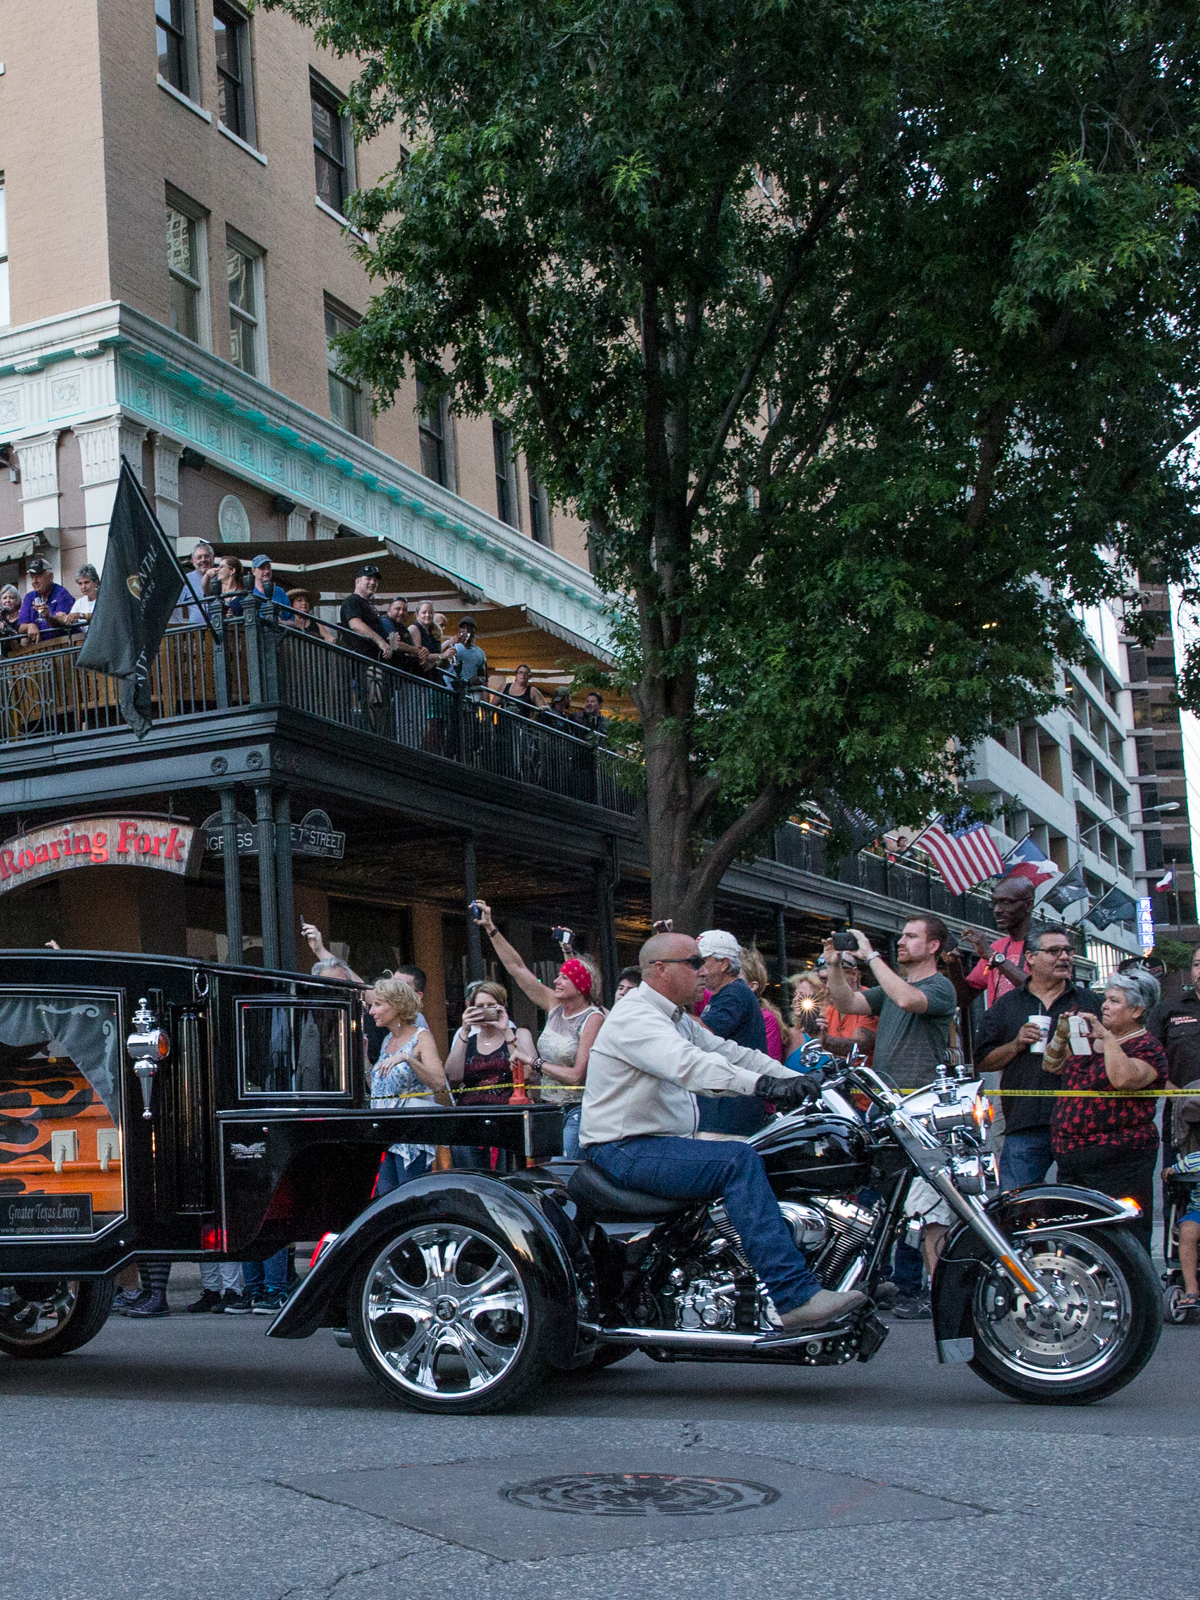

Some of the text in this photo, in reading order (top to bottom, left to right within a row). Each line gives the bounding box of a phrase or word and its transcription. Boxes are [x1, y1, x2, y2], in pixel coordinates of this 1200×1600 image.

[116, 822, 185, 862] Fork
[309, 830, 342, 849] STREET
[8, 1204, 34, 1225] Greater
[35, 1202, 56, 1222] Texas
